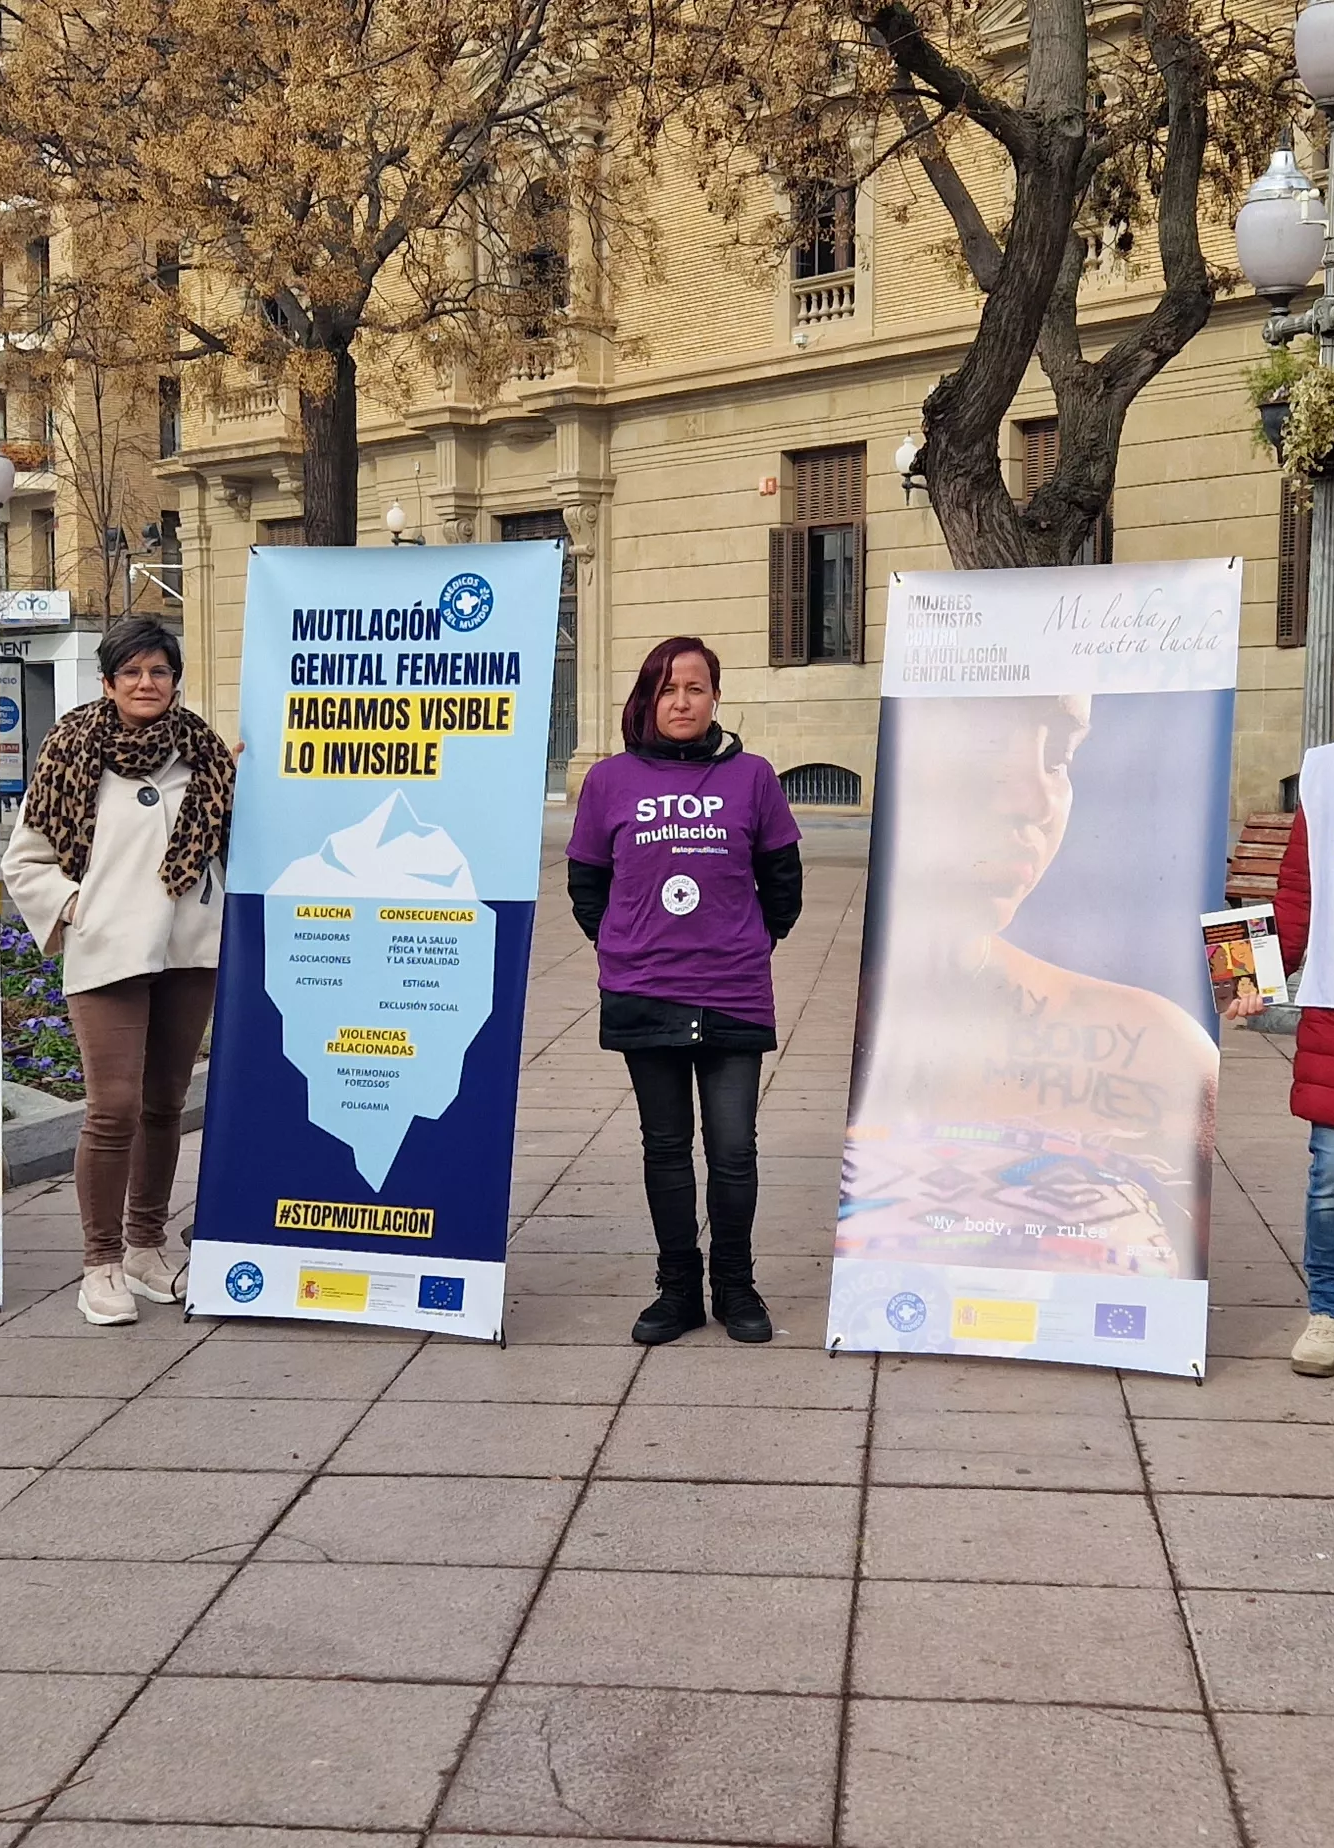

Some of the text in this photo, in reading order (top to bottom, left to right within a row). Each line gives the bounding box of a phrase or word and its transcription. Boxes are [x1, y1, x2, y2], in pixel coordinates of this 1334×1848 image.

[442, 577, 489, 629] MÉDICOS DEL MUNDO
[908, 594, 971, 611] MUJERES
[1043, 588, 1168, 635] Mi lucha,
[292, 601, 441, 641] MUTILACIÓN
[907, 612, 983, 628] ACTIVISTAS
[906, 630, 958, 646] CONTRA
[1071, 610, 1223, 655] nuestra lucha
[904, 644, 1007, 665] LA MUTILACIÓN
[290, 652, 521, 686] GENITAL FEMENINA
[902, 664, 1031, 682] GENITAL FEMENINA
[288, 697, 510, 730] HAGAMOS VISIBLE
[284, 741, 437, 775] LO INVISIBLE
[636, 795, 724, 822] STOP
[636, 824, 727, 845] mutilación
[297, 907, 352, 920] LA LUCHA
[380, 910, 473, 922] CONSECUENCIAS
[293, 932, 351, 942] MEDIADORAS
[392, 935, 458, 945] PARA LA SALUD
[389, 945, 459, 956] FÍSICA Y MENTAL
[289, 954, 352, 964] ASOCIACIONES
[387, 956, 460, 966] Y LA SEXUALIDAD
[295, 977, 343, 987] ACTIVISTAS
[402, 979, 440, 989] ESTIGMA
[379, 1000, 459, 1012] EXCLUSIÓN SOCIAL
[339, 1028, 407, 1042] VIOLENCIAS
[327, 1042, 414, 1056] RELACIONADAS
[336, 1067, 400, 1079] MATRIMONIOS
[344, 1078, 390, 1089] FORZOSOS
[341, 1100, 390, 1111] POLIGAMIA
[279, 1204, 430, 1234] #STOPMUTILACIÓN
[964, 1216, 1012, 1236] body,
[1024, 1223, 1047, 1238] my
